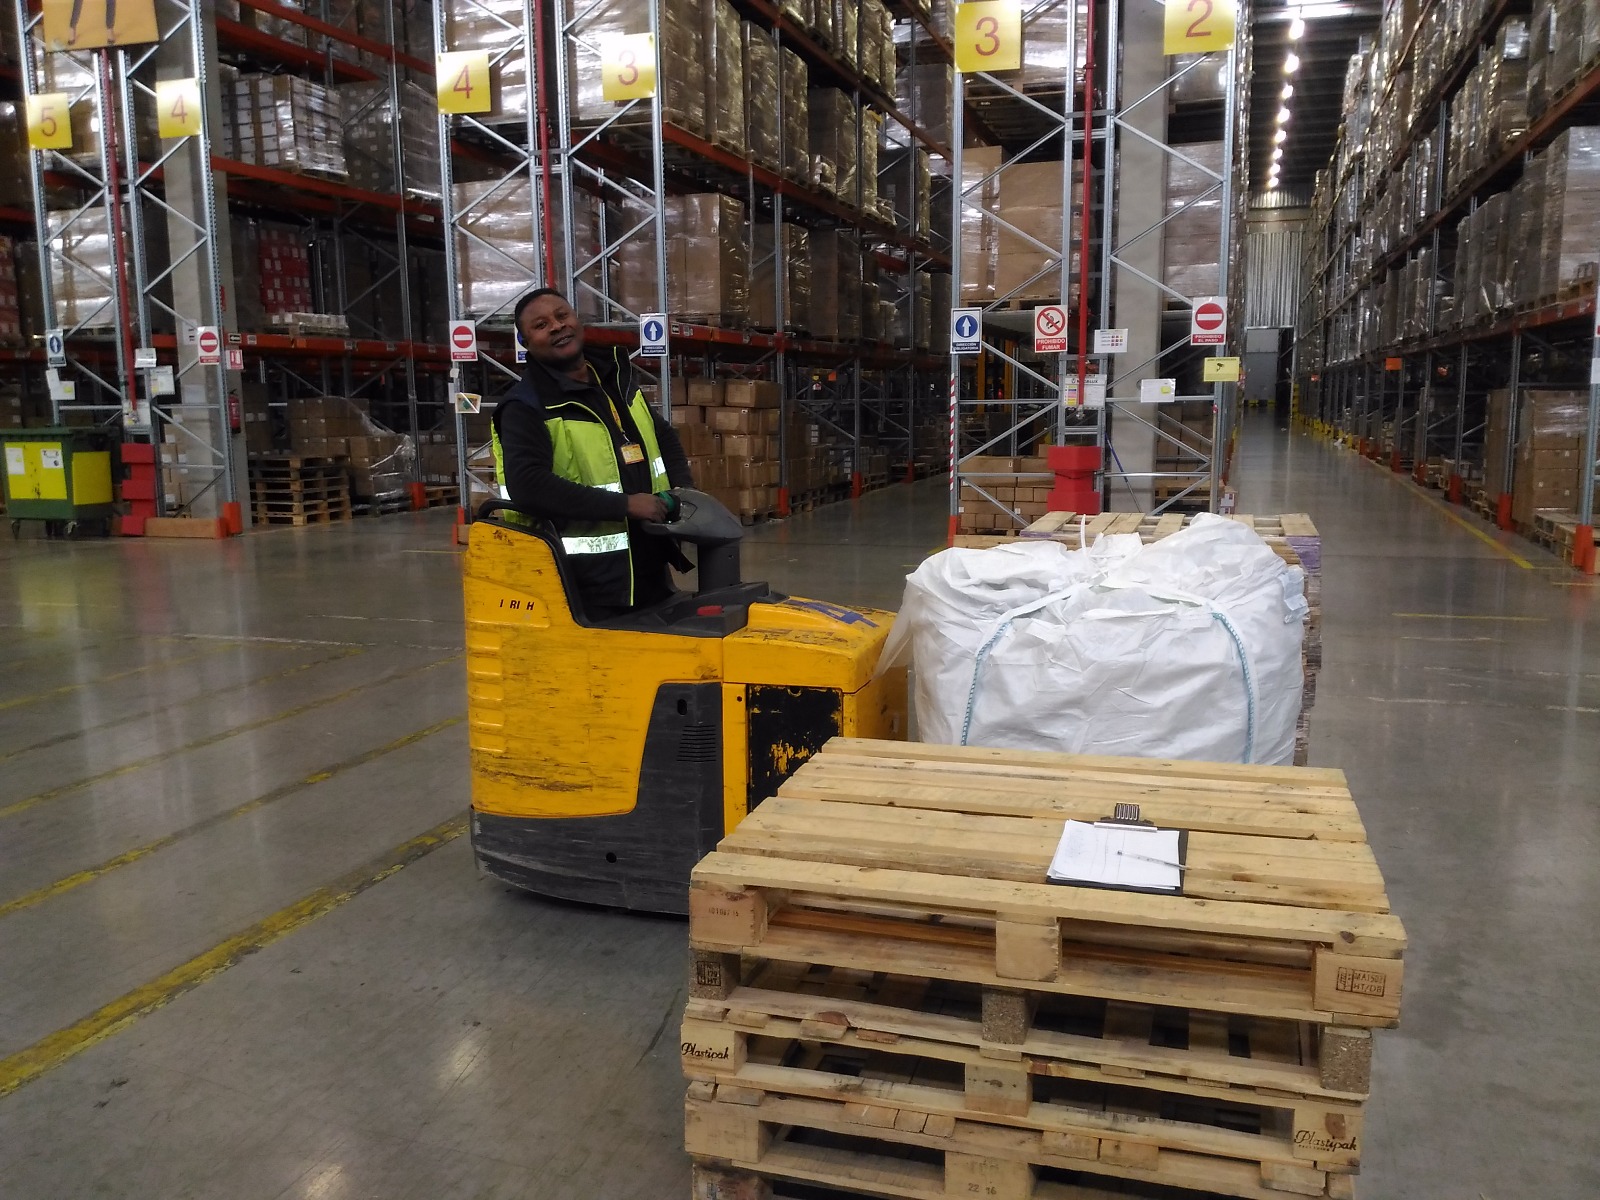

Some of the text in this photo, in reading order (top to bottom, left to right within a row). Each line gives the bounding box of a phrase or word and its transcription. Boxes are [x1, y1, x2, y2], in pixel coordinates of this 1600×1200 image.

[1186, 0, 1213, 39] 2
[975, 16, 1001, 57] 3
[453, 64, 474, 100] 4
[617, 49, 640, 87] 3
[40, 106, 57, 137] 5
[171, 93, 188, 124] 4
[681, 1042, 729, 1062] Plastipak
[1294, 1129, 1357, 1153] Plastipak
[967, 1182, 980, 1193] 22
